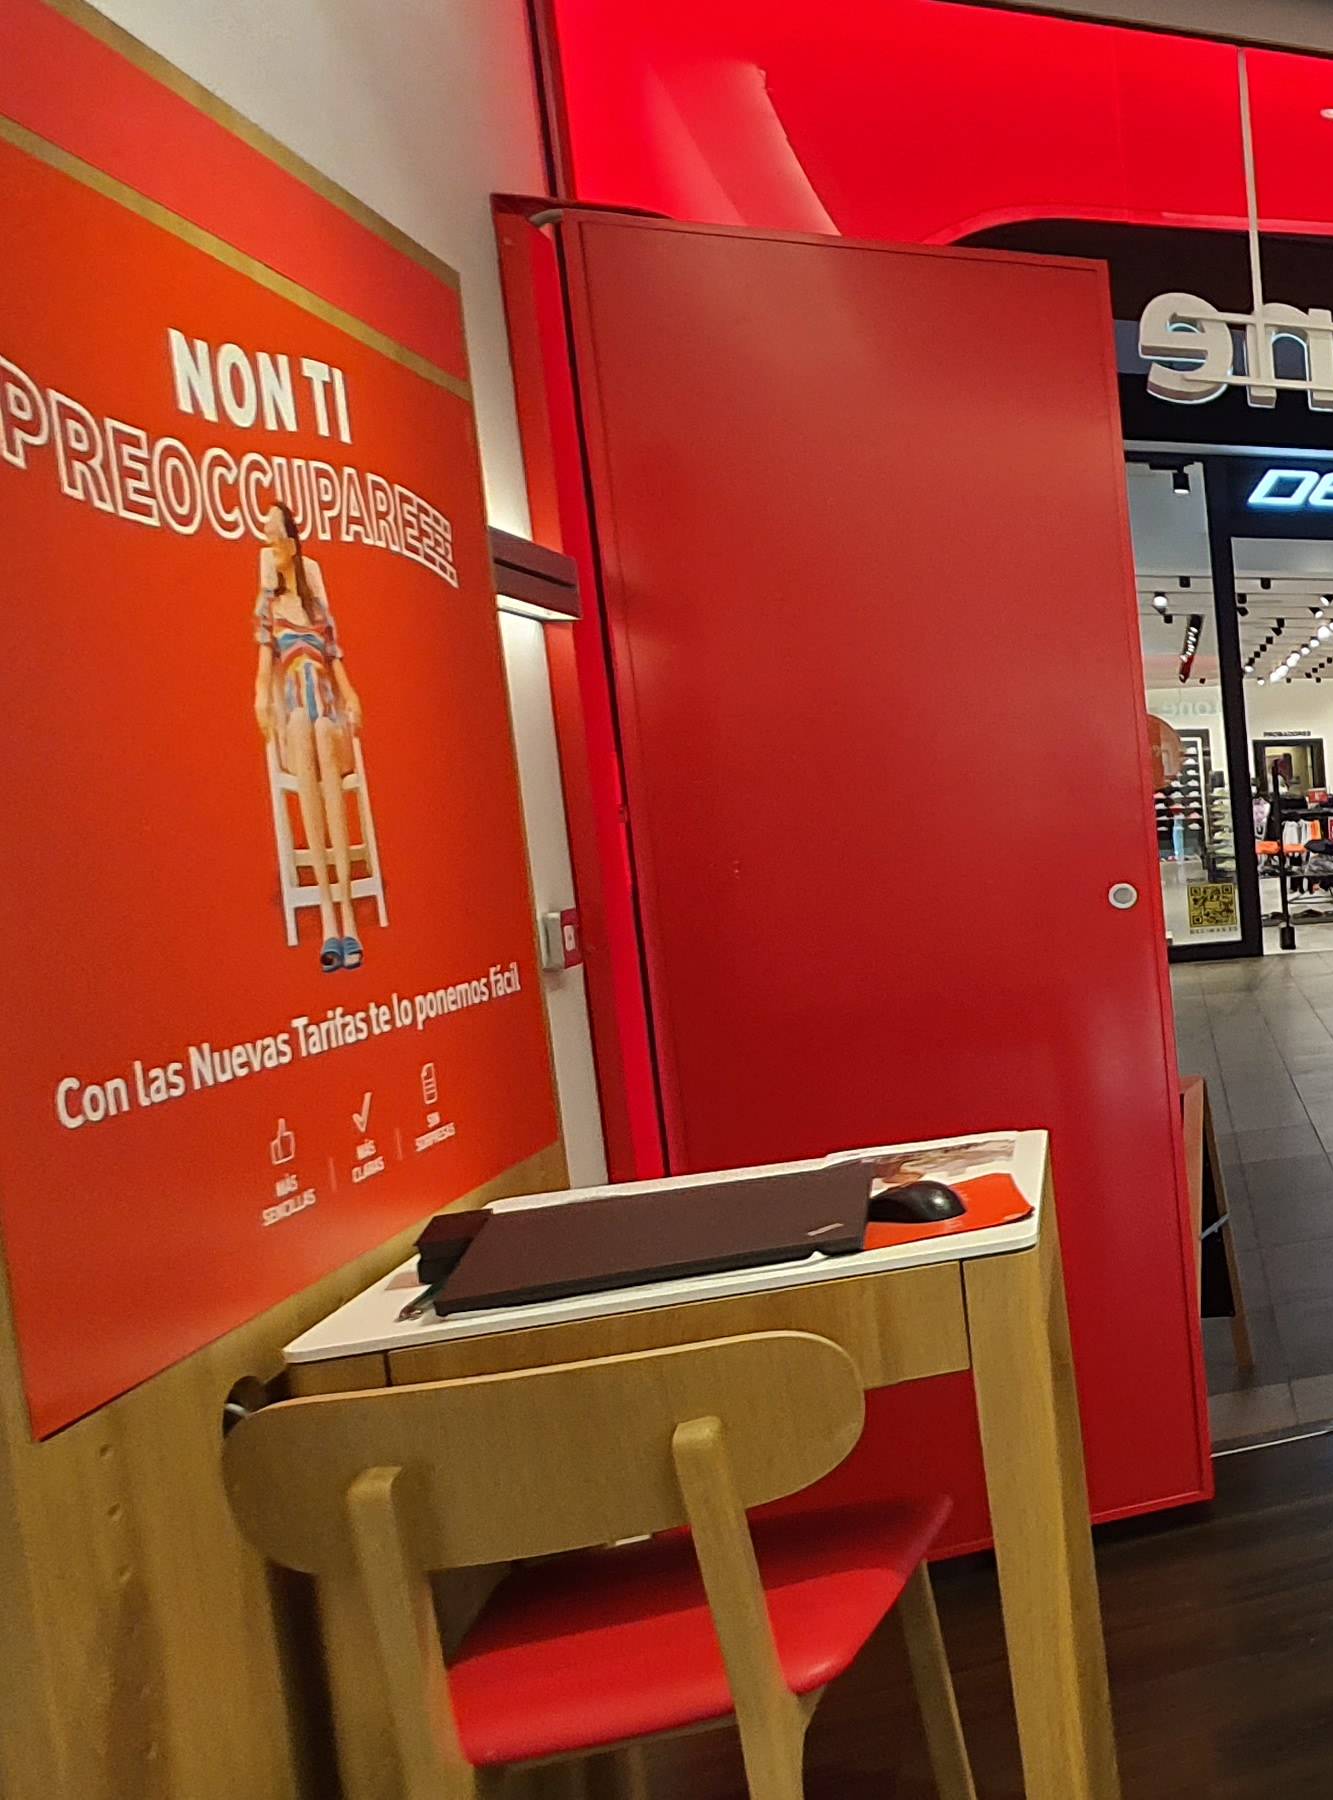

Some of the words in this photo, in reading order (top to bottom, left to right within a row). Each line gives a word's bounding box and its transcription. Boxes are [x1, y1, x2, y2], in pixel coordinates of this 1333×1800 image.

[167, 327, 297, 433] NON
[301, 356, 352, 444] TI
[56, 1077, 129, 1131] Con
[134, 1060, 185, 1108] las
[188, 1031, 293, 1091] Nuevas
[292, 1008, 368, 1058] Tarifas
[369, 1001, 393, 1036] te
[392, 993, 412, 1027] lo
[416, 976, 489, 1030] ponemos
[489, 961, 522, 999] fácil
